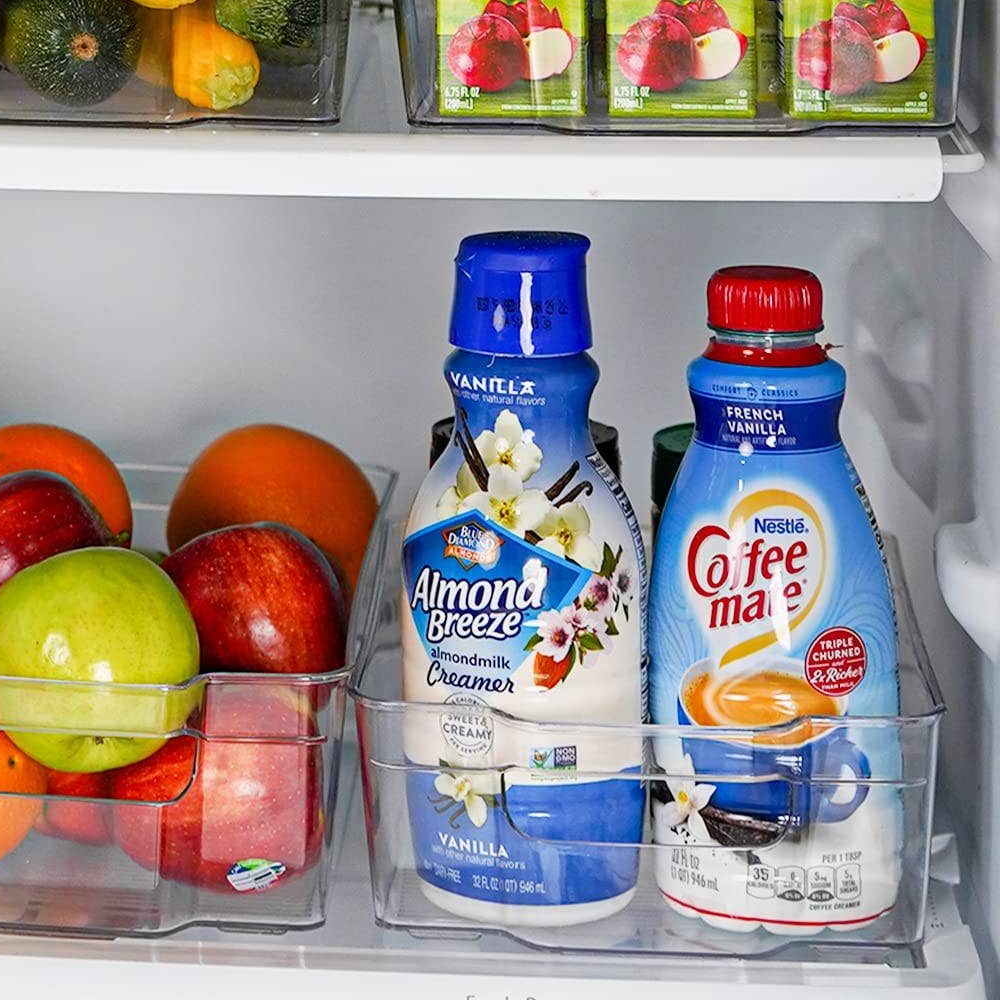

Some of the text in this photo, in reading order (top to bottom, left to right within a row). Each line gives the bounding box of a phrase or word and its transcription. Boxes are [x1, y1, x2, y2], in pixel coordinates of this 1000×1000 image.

[450, 371, 536, 395] VANILLA
[482, 393, 513, 405] natural
[516, 394, 546, 406] flavors
[726, 405, 784, 421] FRENCH
[727, 420, 787, 435] VANILLA
[460, 525, 484, 540] BLUE
[687, 524, 808, 598] Coffee
[411, 565, 549, 612] Almond
[708, 580, 802, 629] mae
[427, 608, 522, 642] Breeze
[820, 637, 854, 650] TRIPLE
[430, 646, 512, 670] almondmilk
[812, 646, 861, 662] CHURNED
[426, 660, 515, 694] Creamer
[448, 713, 480, 726] SWEET
[442, 722, 493, 741] CREAMY
[555, 746, 576, 755] NON
[438, 831, 509, 859] VANILLA
[466, 854, 495, 867] natural
[690, 871, 706, 888] 946
[753, 867, 769, 881] 35
[519, 880, 534, 894] 946
